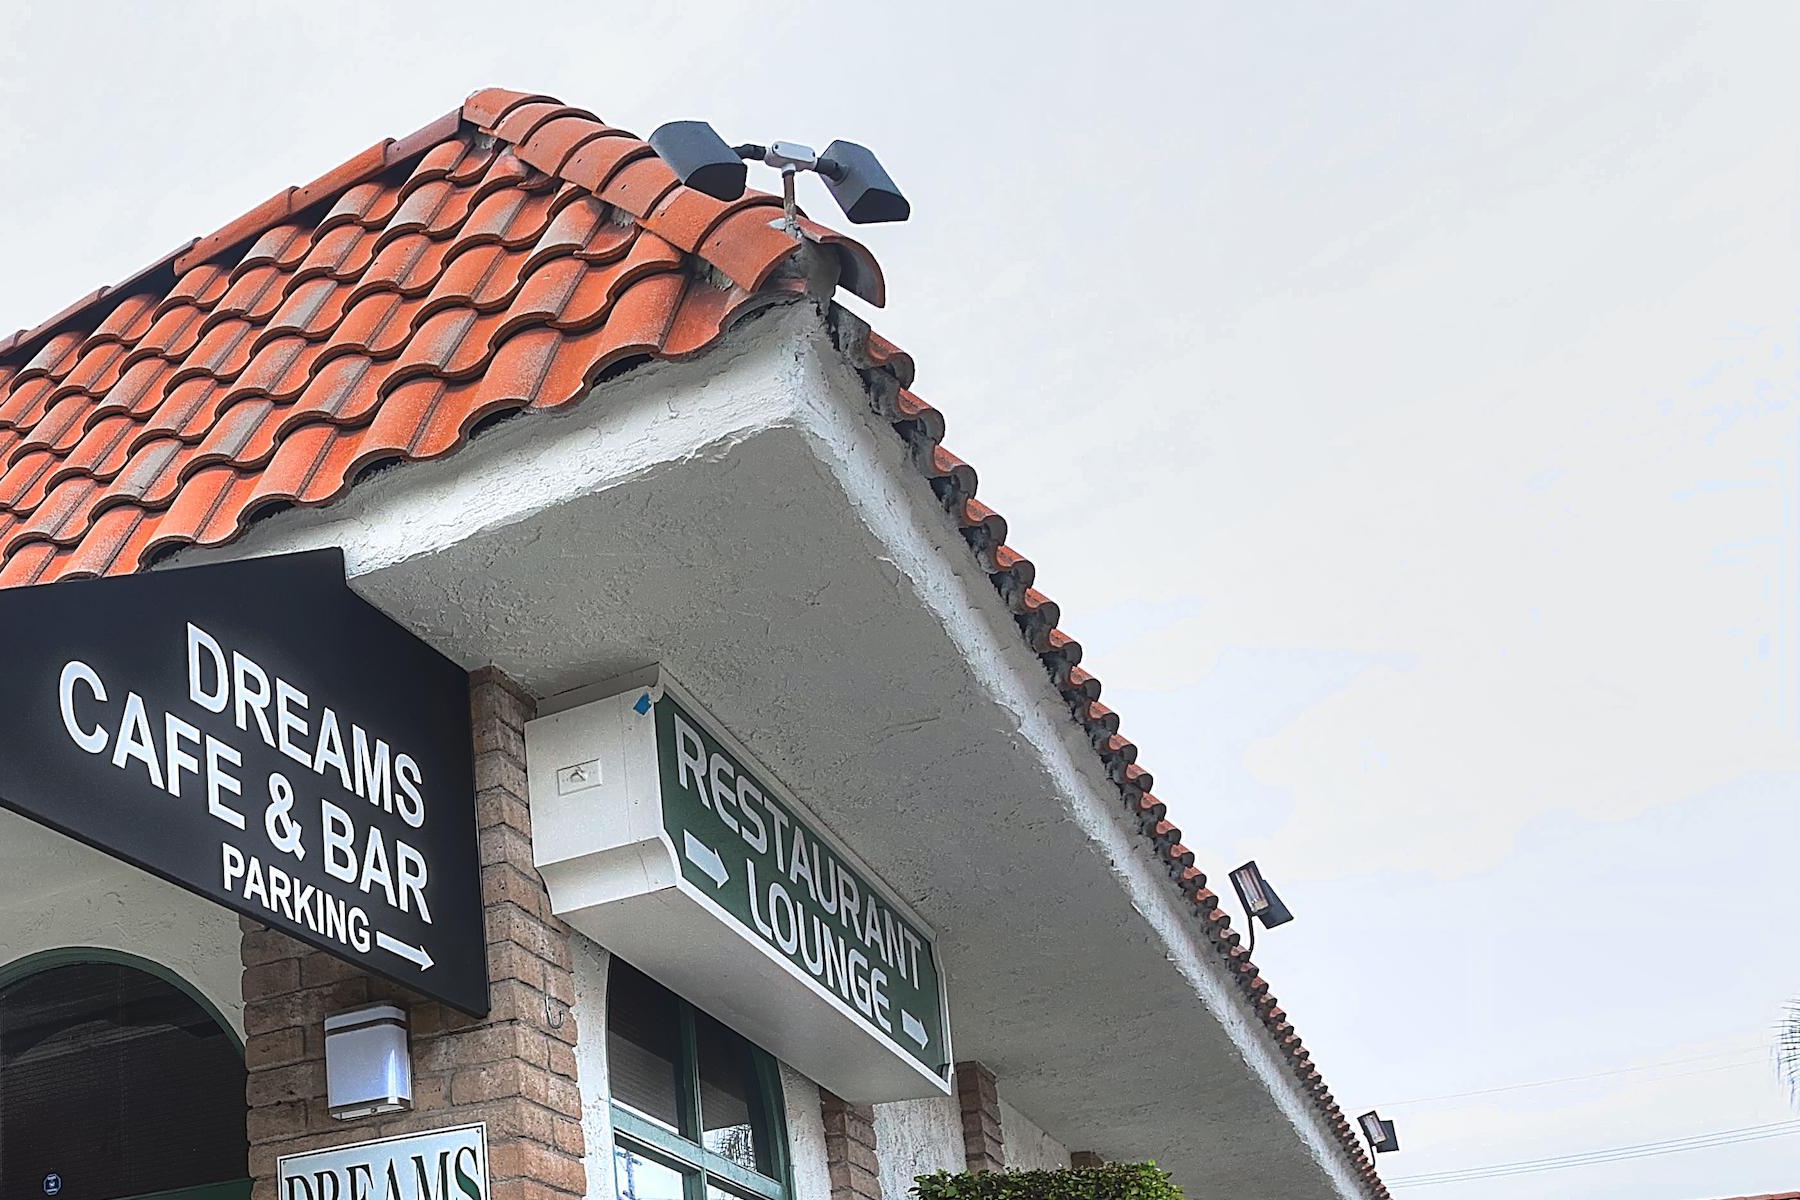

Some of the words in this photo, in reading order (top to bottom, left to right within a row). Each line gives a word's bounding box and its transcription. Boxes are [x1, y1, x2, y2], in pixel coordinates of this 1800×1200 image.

[59, 660, 246, 831] CAFE
[265, 772, 306, 862] &
[321, 798, 432, 925] BAR
[187, 621, 425, 828] DREAMS
[222, 842, 371, 953] PARKING
[674, 713, 922, 990] RESTAURANT
[746, 858, 892, 1033] LOUNGE
